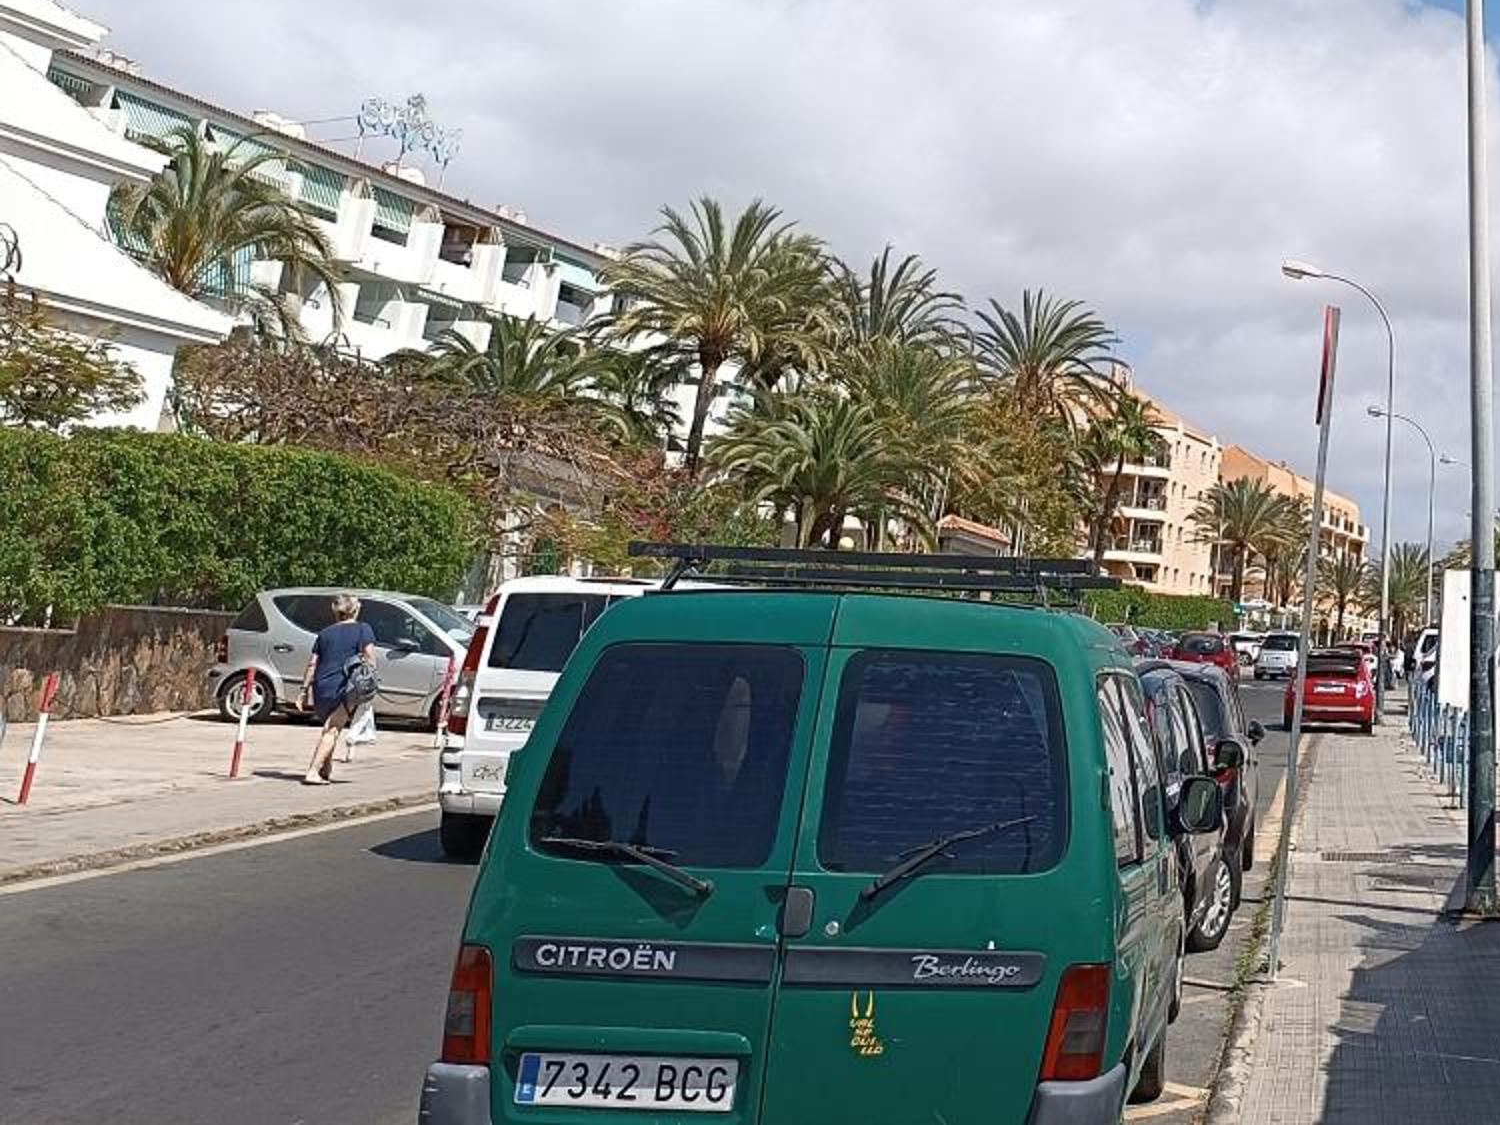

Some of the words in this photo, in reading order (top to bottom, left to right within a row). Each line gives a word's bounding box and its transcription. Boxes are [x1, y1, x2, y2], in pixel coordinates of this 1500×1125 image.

[536, 944, 676, 970] CITROËN
[911, 955, 1021, 984] Berlingo
[540, 1060, 640, 1100] 7342
[654, 1064, 728, 1103] BCG
